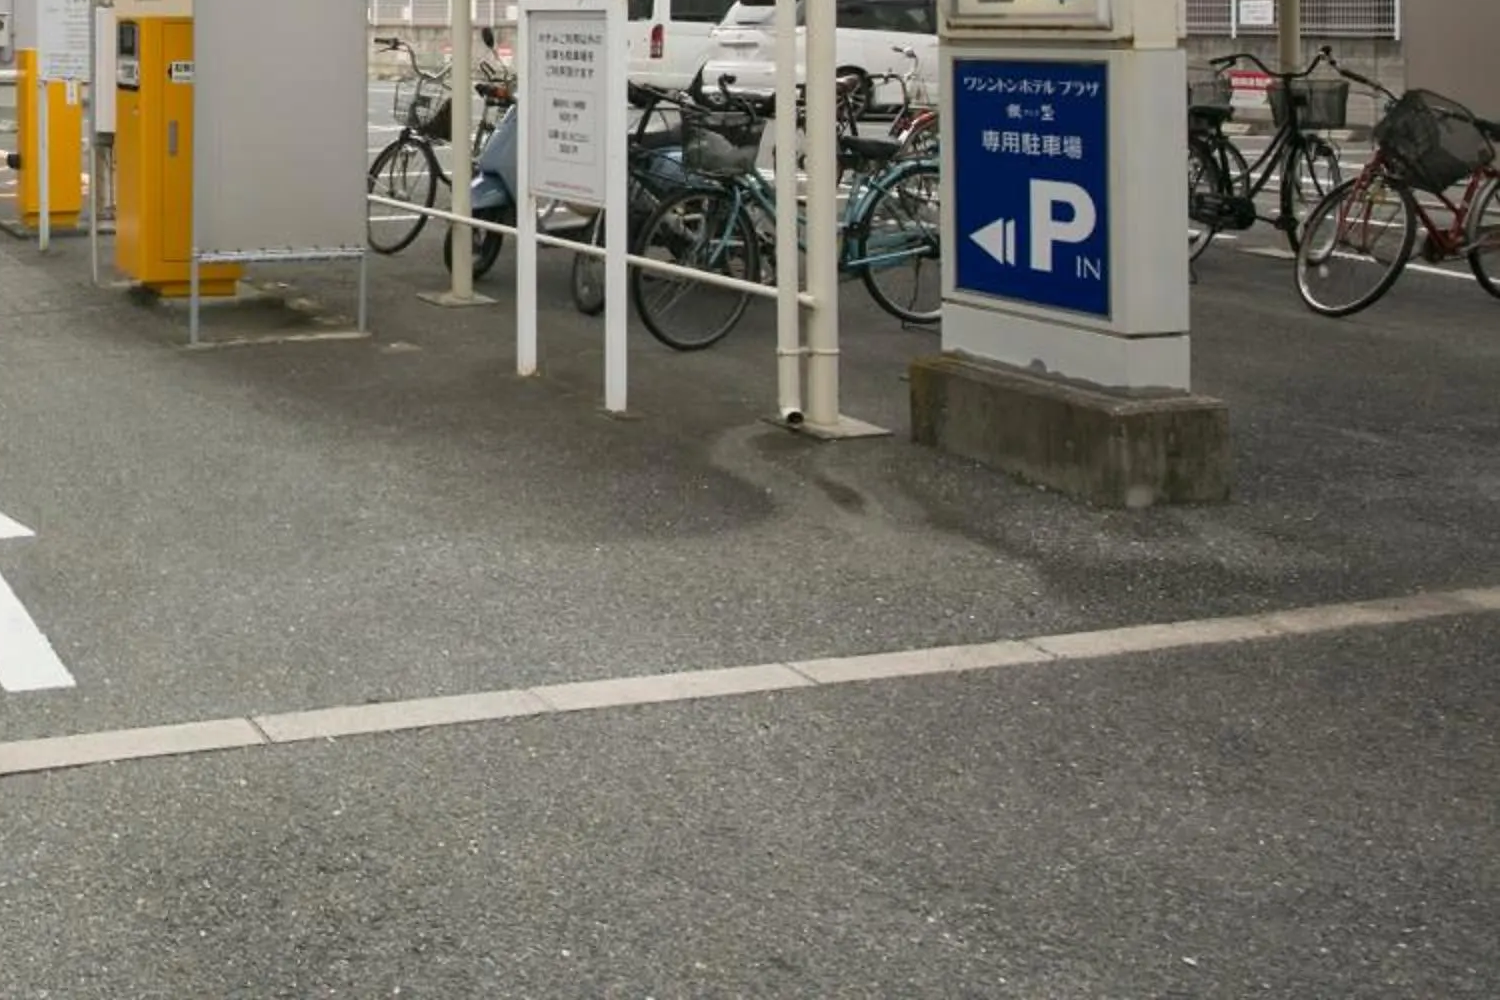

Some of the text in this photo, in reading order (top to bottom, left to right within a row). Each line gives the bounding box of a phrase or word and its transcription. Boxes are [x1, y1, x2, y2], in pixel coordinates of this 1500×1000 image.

[963, 76, 1100, 98] ワシントンホテル プラザ
[981, 129, 1083, 160] 専用駐車場
[1029, 178, 1097, 273] P
[1076, 254, 1101, 281] IN
